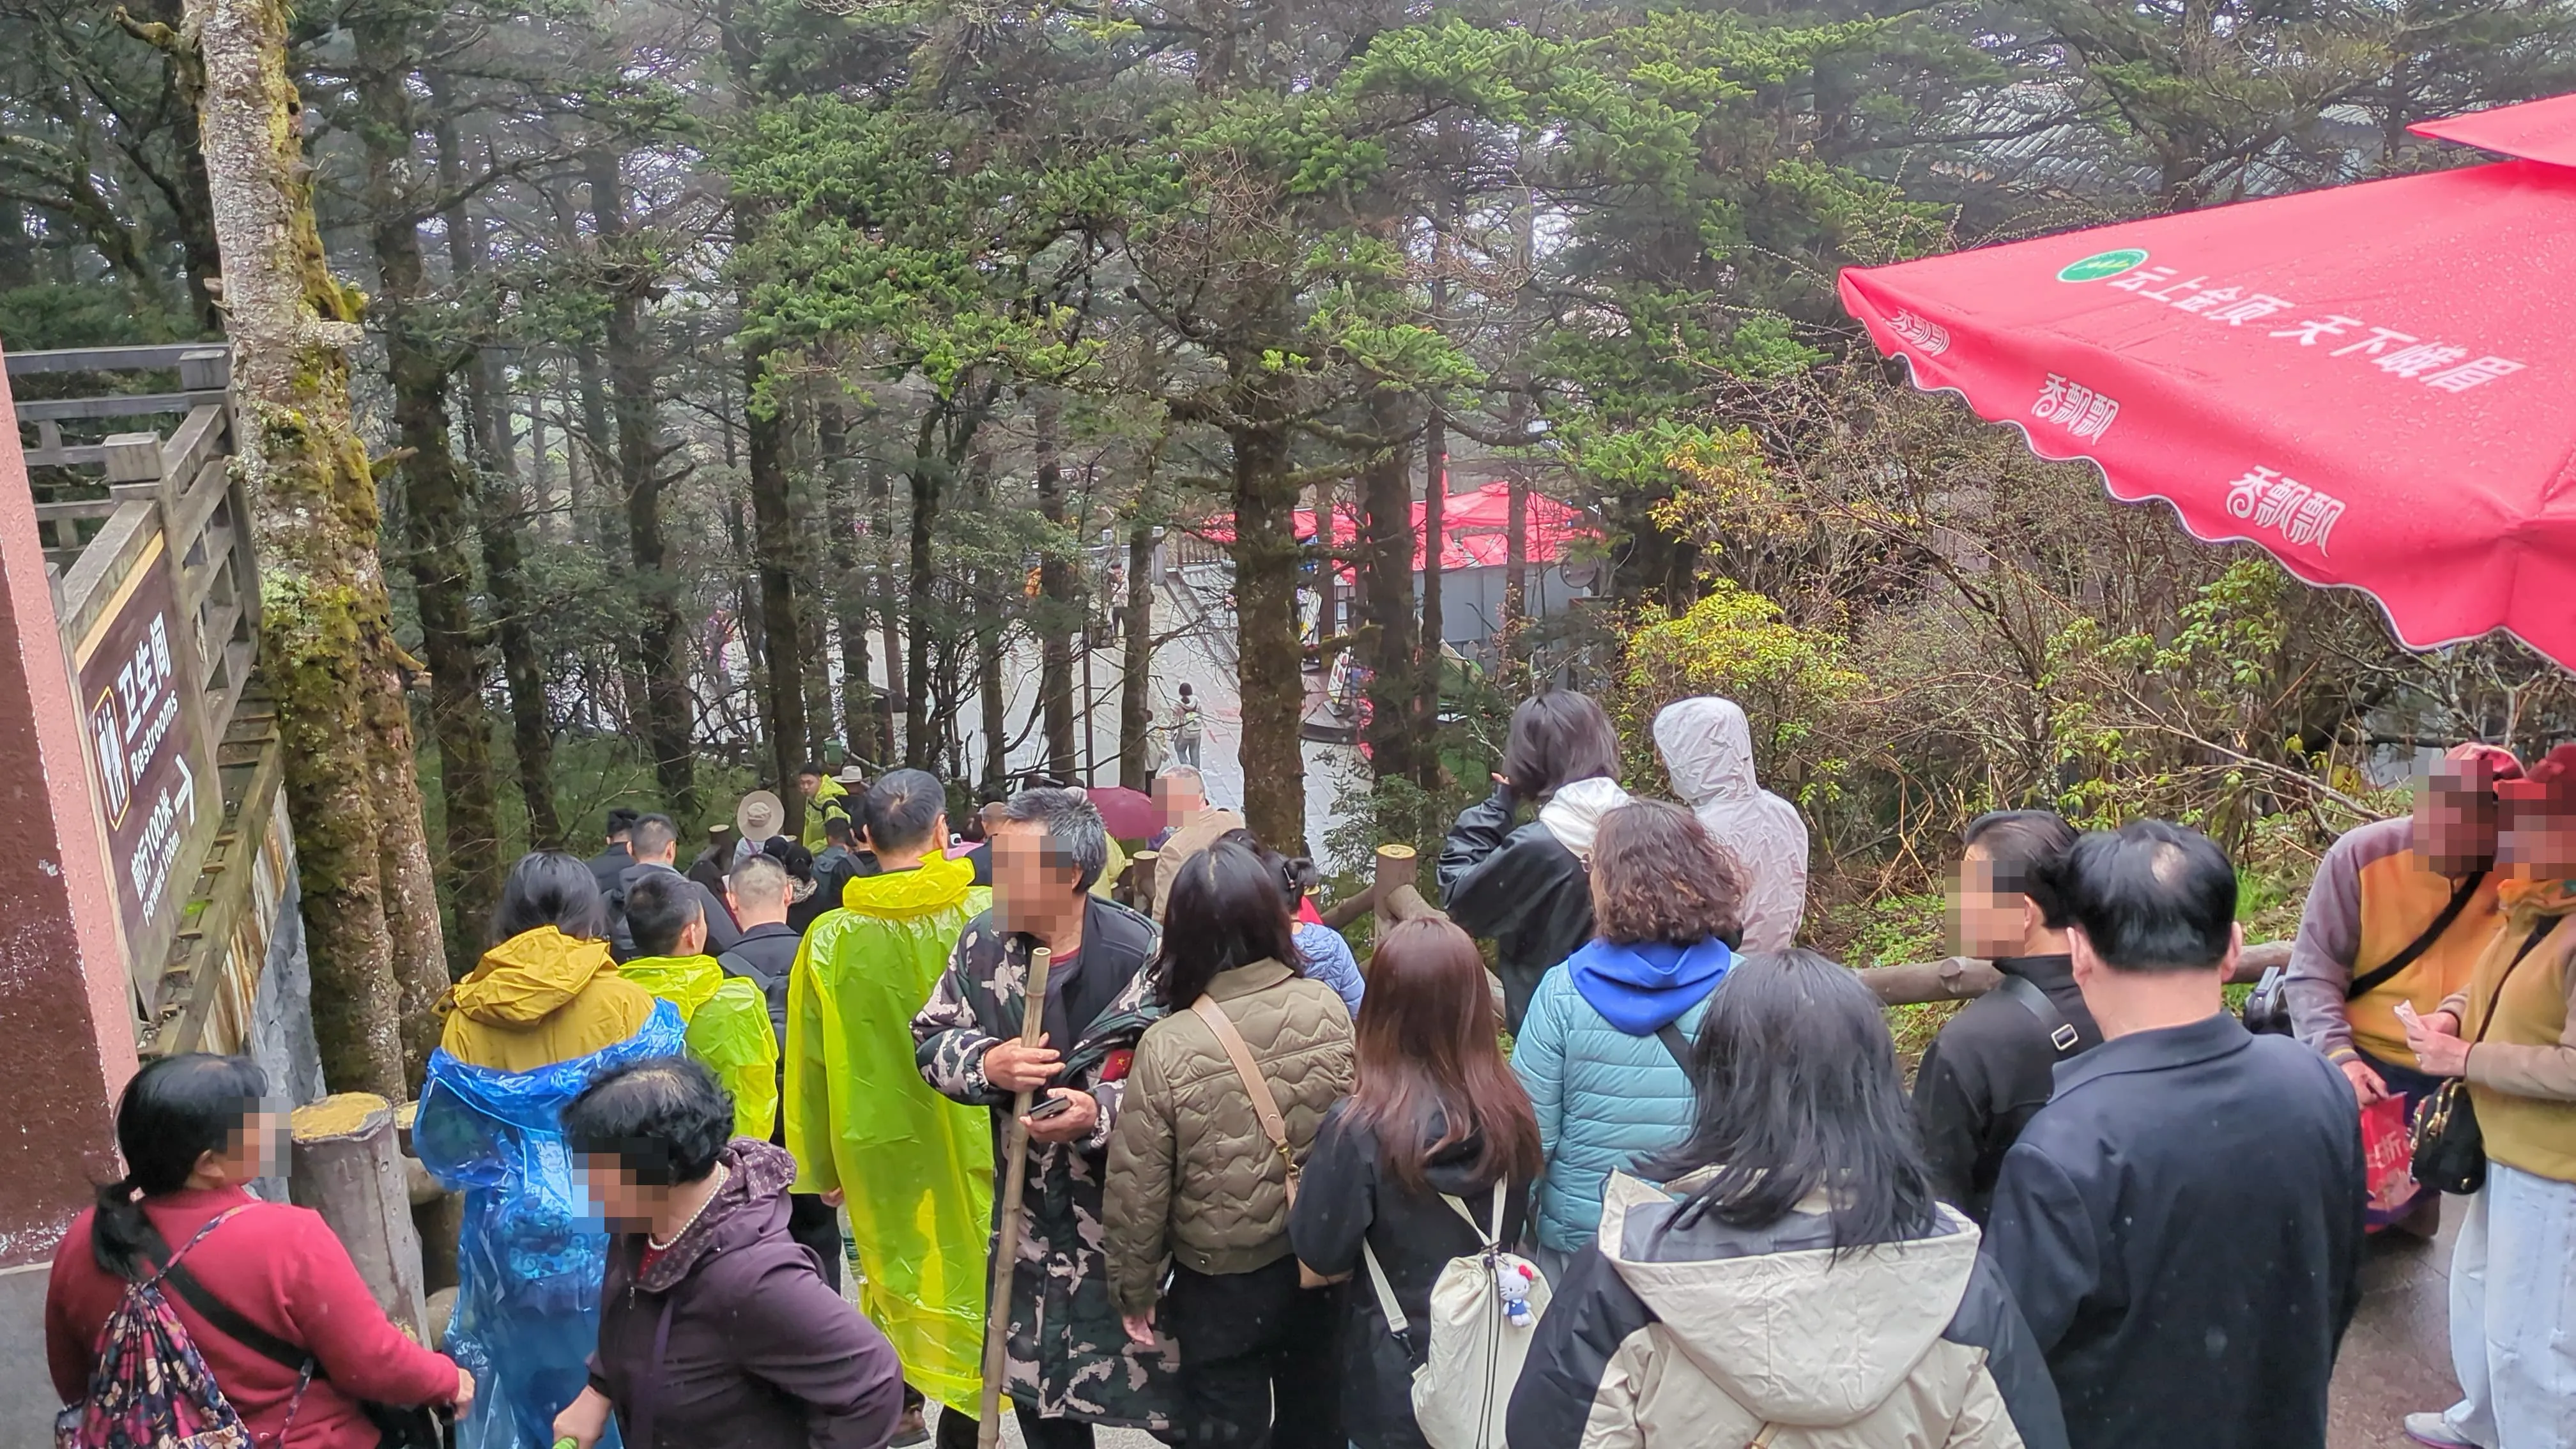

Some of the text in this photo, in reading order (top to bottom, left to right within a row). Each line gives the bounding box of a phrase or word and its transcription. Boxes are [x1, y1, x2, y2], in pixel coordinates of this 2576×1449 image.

[2106, 266, 2527, 393] 云上金顶 天下峨眉
[2031, 372, 2120, 445] 香飘飘
[2225, 466, 2347, 558] 香飘飘
[118, 611, 171, 745] 卫生间
[130, 688, 178, 786] Restrooms
[131, 786, 174, 901] 前行100米
[142, 830, 180, 927] Forward 100m
